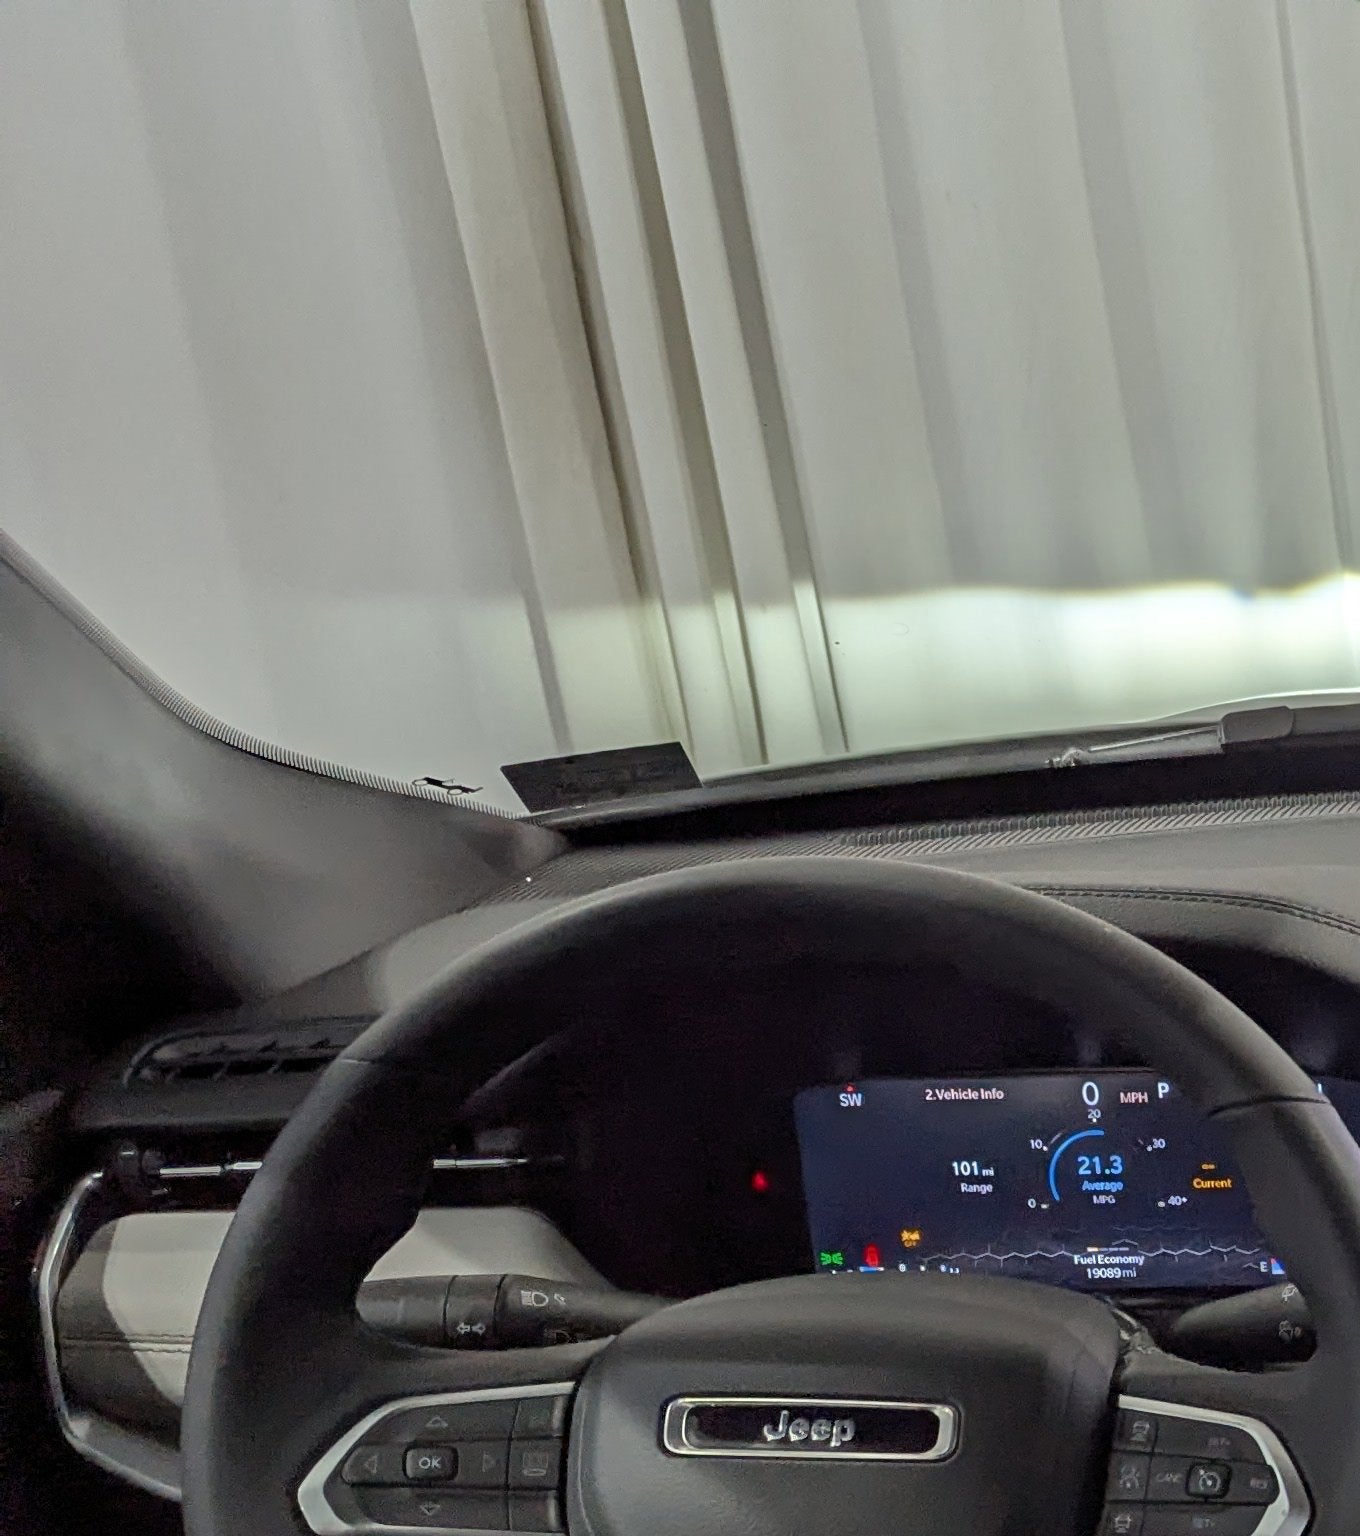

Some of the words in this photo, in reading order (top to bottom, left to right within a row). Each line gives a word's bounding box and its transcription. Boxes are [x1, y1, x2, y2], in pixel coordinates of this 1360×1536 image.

[981, 1088, 1005, 1100] Info
[1082, 1081, 1100, 1106] 0
[1120, 1091, 1148, 1105] MPH
[1158, 1082, 1170, 1099] P
[839, 1093, 863, 1107] SW
[1087, 1109, 1101, 1119] 20
[1030, 1139, 1043, 1149] 10
[1153, 1138, 1166, 1149] 30
[952, 1161, 979, 1177] 101
[982, 1166, 995, 1177] mi
[1077, 1155, 1123, 1176] 21.3
[960, 1182, 993, 1194] Range
[1082, 1180, 1124, 1192] Average
[1193, 1177, 1232, 1189] Current
[1028, 1199, 1037, 1209] 0
[1093, 1195, 1116, 1204] MPG
[1073, 1254, 1096, 1265] Fuel
[1098, 1254, 1145, 1266] Economy
[1086, 1267, 1121, 1279] 19089
[1122, 1266, 1137, 1278] mi
[1260, 1261, 1268, 1272] E
[763, 1409, 855, 1448] Jeep
[418, 1455, 442, 1470] OK
